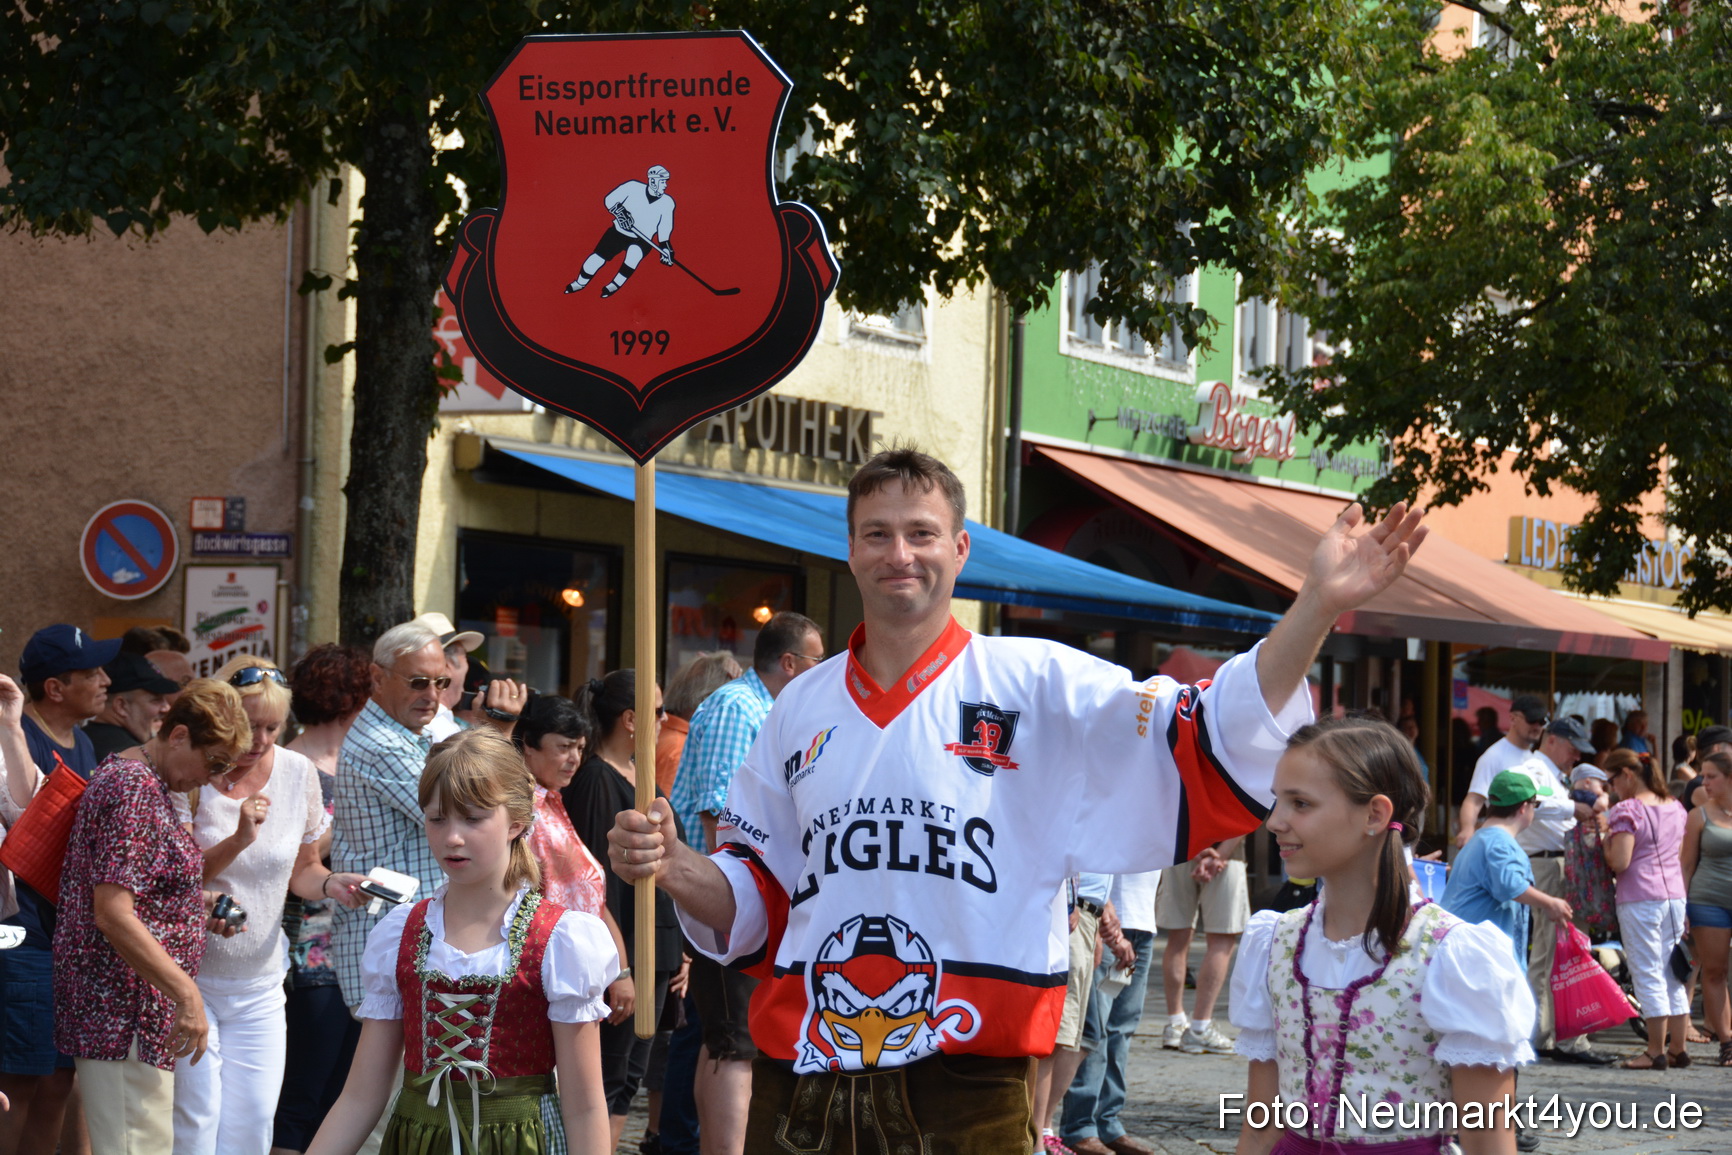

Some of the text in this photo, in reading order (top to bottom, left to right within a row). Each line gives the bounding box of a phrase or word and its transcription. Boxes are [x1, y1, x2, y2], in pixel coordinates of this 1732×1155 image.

[518, 69, 752, 106] Eissportfreunde
[534, 108, 677, 136] Neumarkt
[609, 329, 671, 357] 1999
[1190, 380, 1297, 464] Bögerl
[971, 719, 1003, 754] 38
